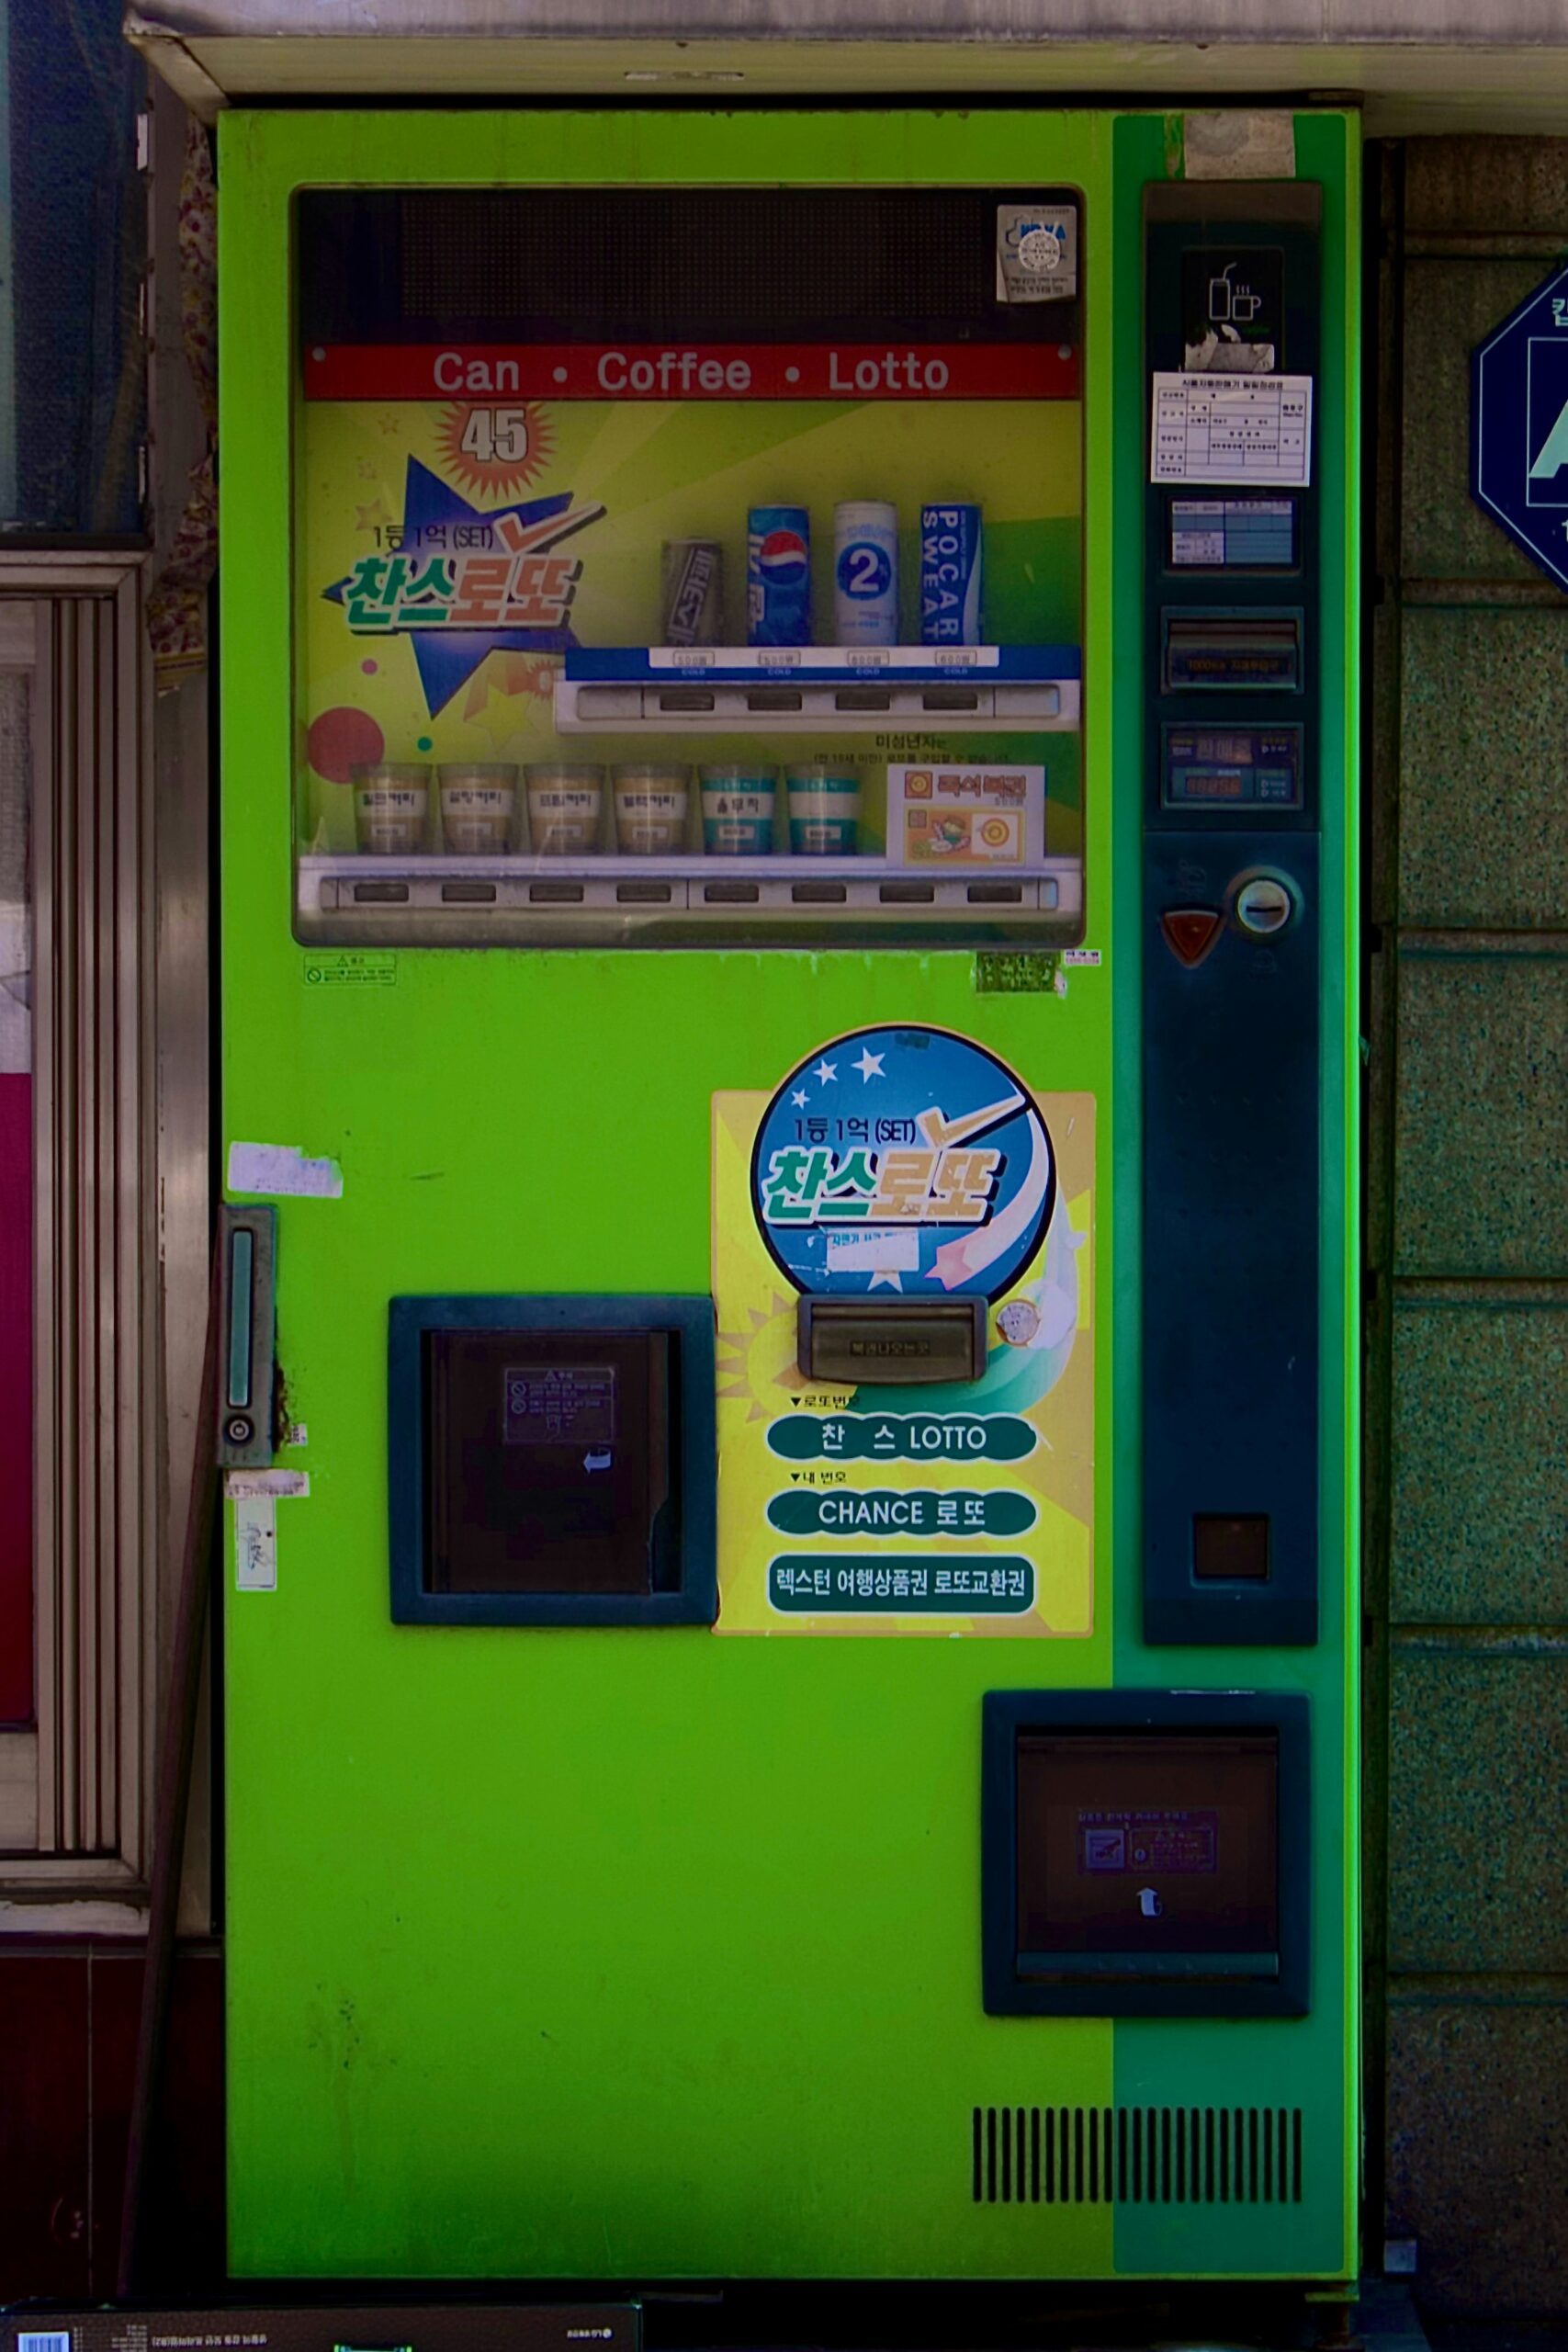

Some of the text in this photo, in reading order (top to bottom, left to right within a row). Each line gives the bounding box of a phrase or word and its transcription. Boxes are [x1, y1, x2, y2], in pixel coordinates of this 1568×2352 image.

[433, 352, 950, 391] Can Coffee Lotto
[461, 407, 528, 462] 45
[374, 525, 494, 550] 1등 1억 (SET)
[922, 510, 940, 639] SWEAT
[346, 554, 581, 628] 찬스로또
[795, 1117, 917, 1144] 1등 1억 (SET)
[765, 1149, 1001, 1221] 찬스로또
[909, 1425, 987, 1450] LOTTO
[803, 1471, 847, 1485] 내 번호
[818, 1500, 924, 1525] CHANCE
[776, 1568, 1026, 1599] 렉스턴 여행상품권 로또교환권
